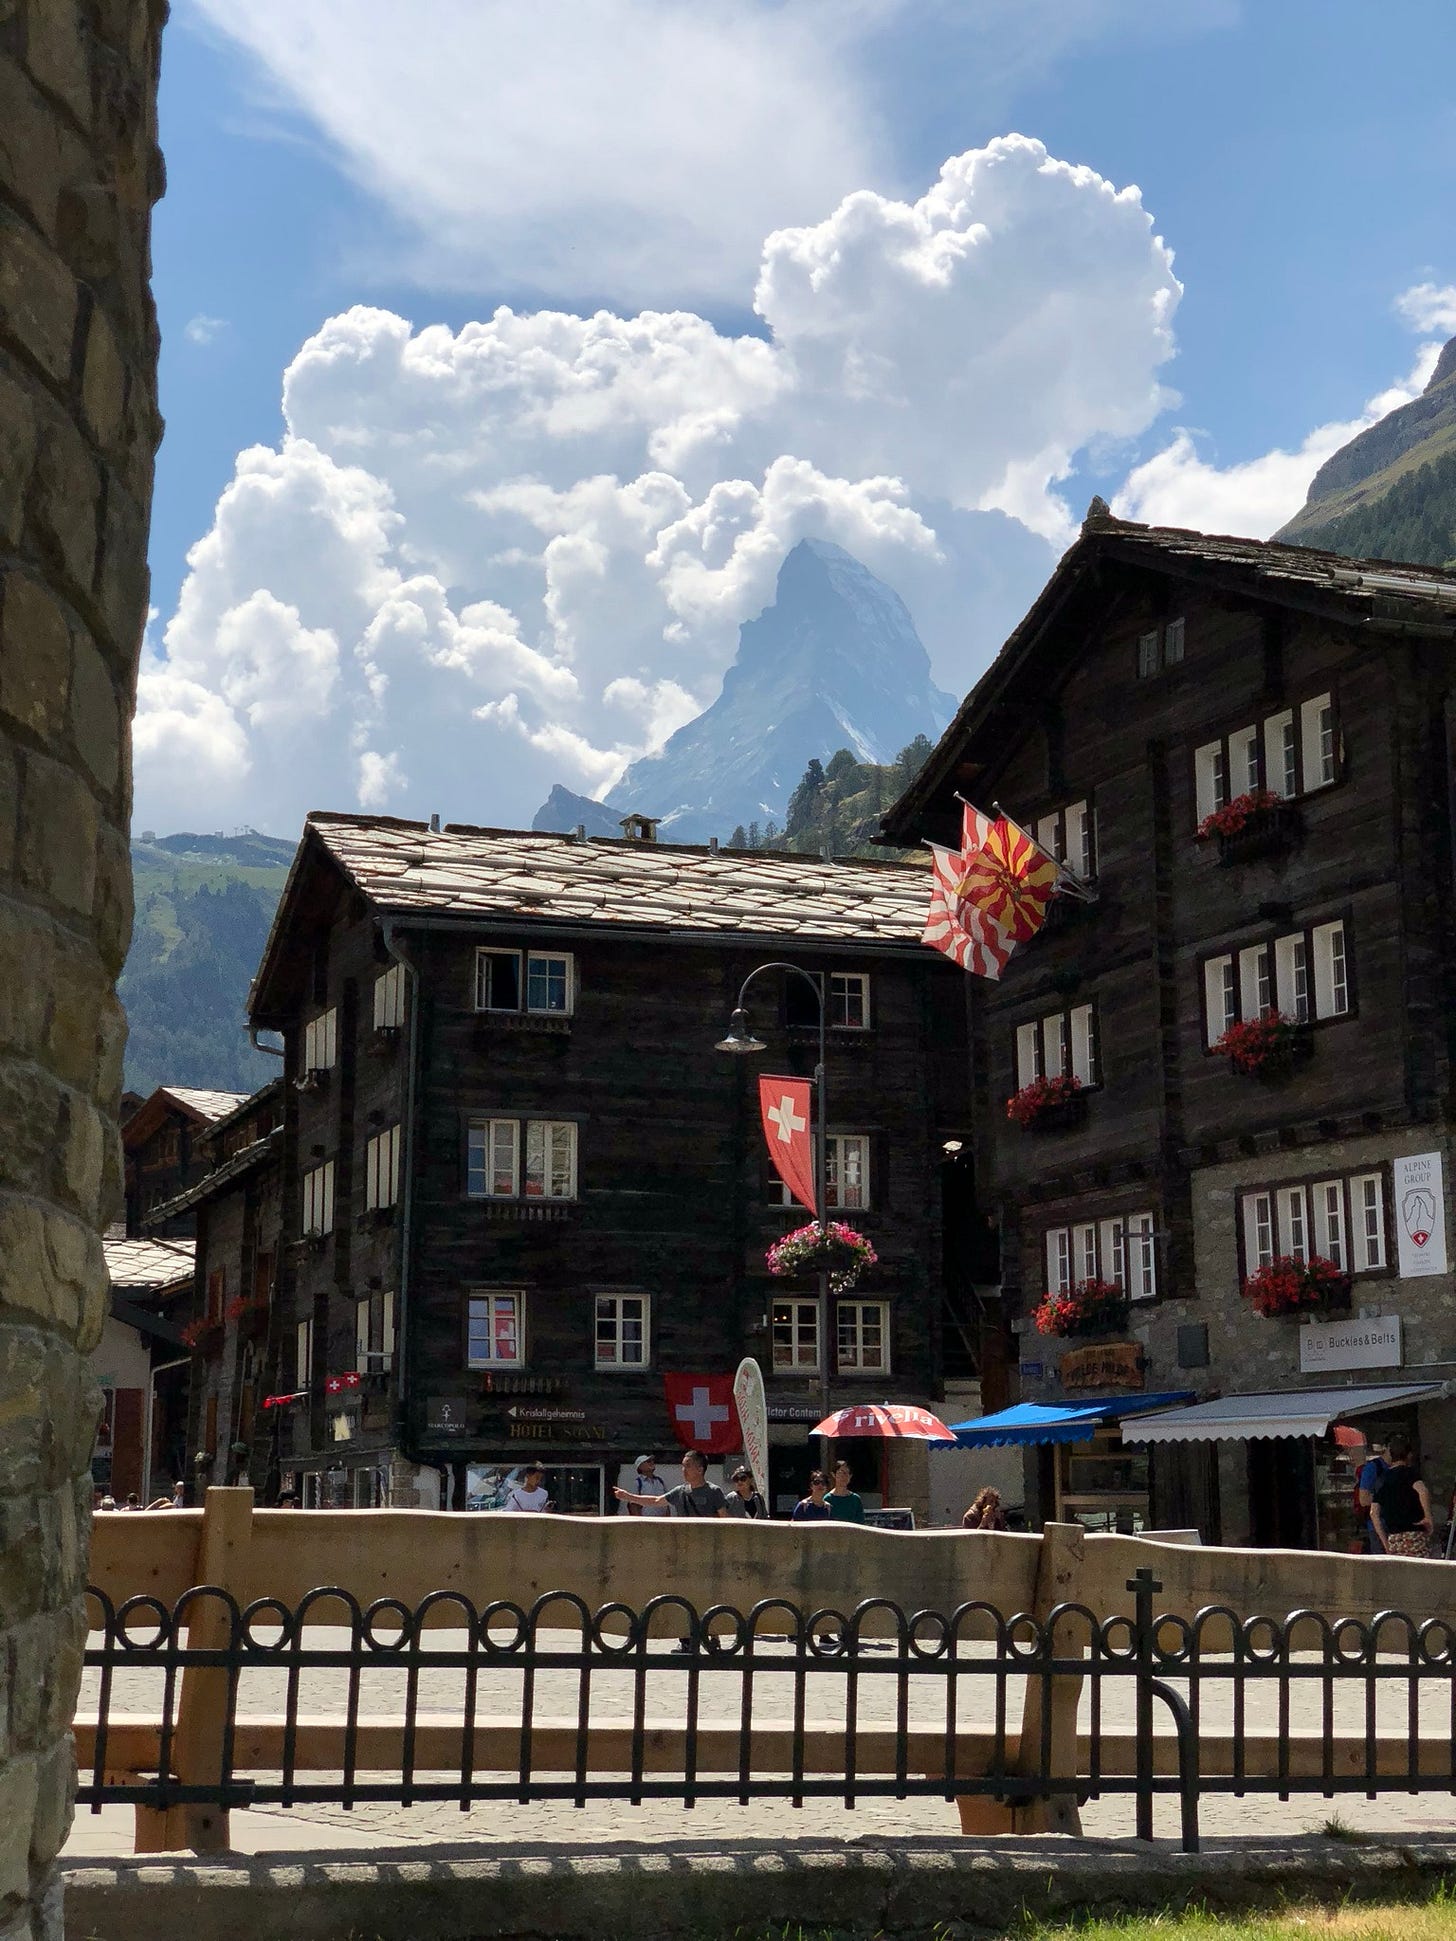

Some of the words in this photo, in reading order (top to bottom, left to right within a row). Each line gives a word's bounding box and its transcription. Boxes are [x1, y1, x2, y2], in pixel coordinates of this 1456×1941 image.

[1403, 1159, 1432, 1173] ALPINE
[1404, 1172, 1432, 1185] GROUP
[767, 1406, 787, 1417] ictor
[855, 1408, 933, 1428] rivella
[509, 1424, 552, 1439] HOTEL
